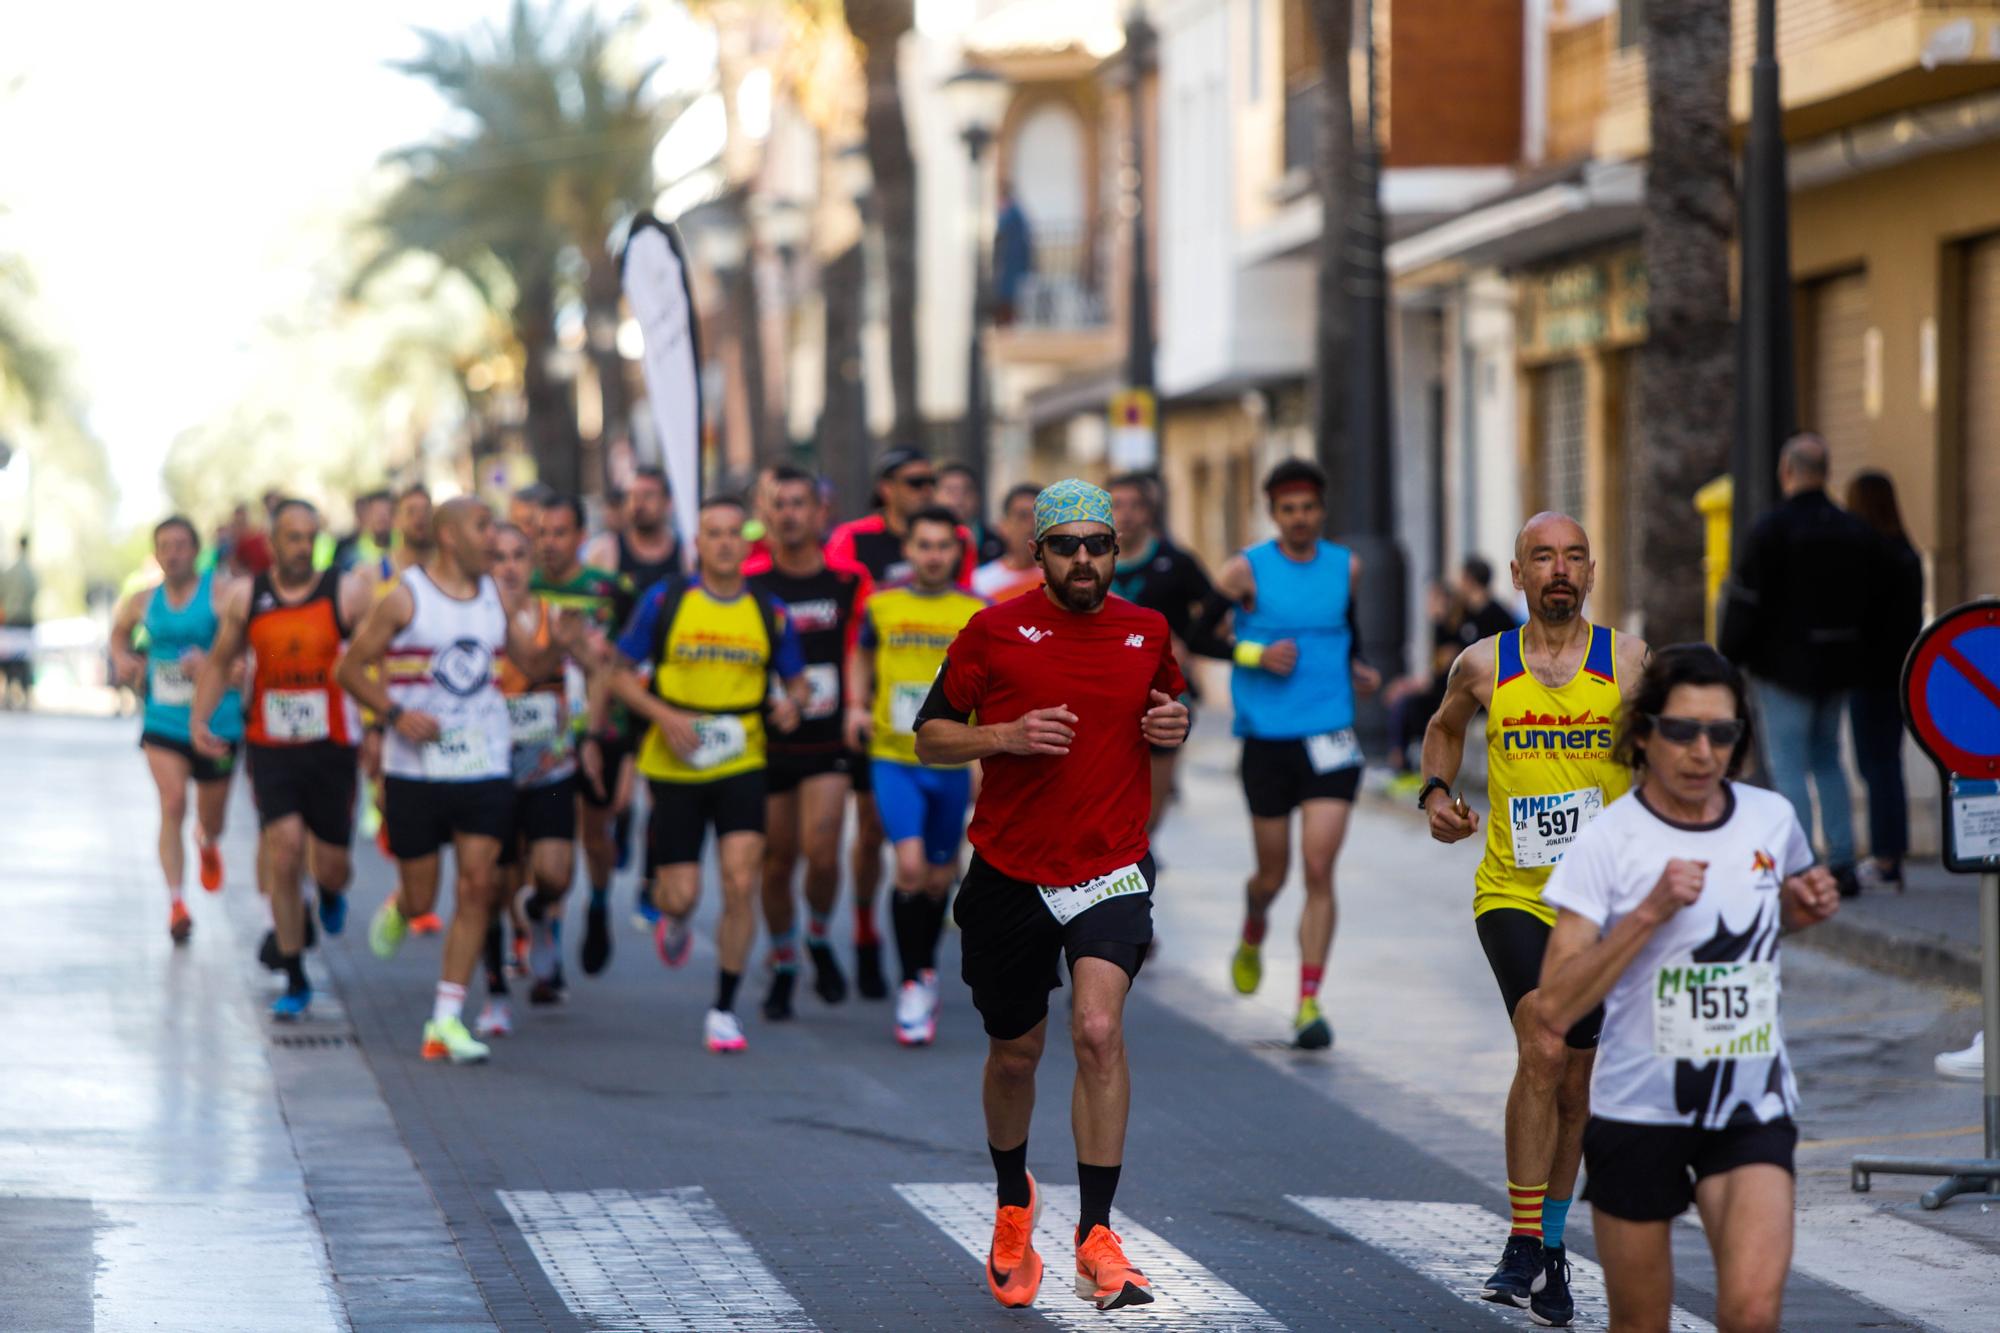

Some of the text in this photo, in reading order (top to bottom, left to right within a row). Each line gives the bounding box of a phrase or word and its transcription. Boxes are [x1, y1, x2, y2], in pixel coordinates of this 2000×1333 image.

[1503, 729, 1612, 750] runners
[1506, 752, 1540, 761] CIUTAT
[1546, 752, 1559, 760] DE
[1537, 807, 1580, 838] 597
[1084, 879, 1107, 895] HECTOR
[1688, 985, 1750, 1020] 1513
